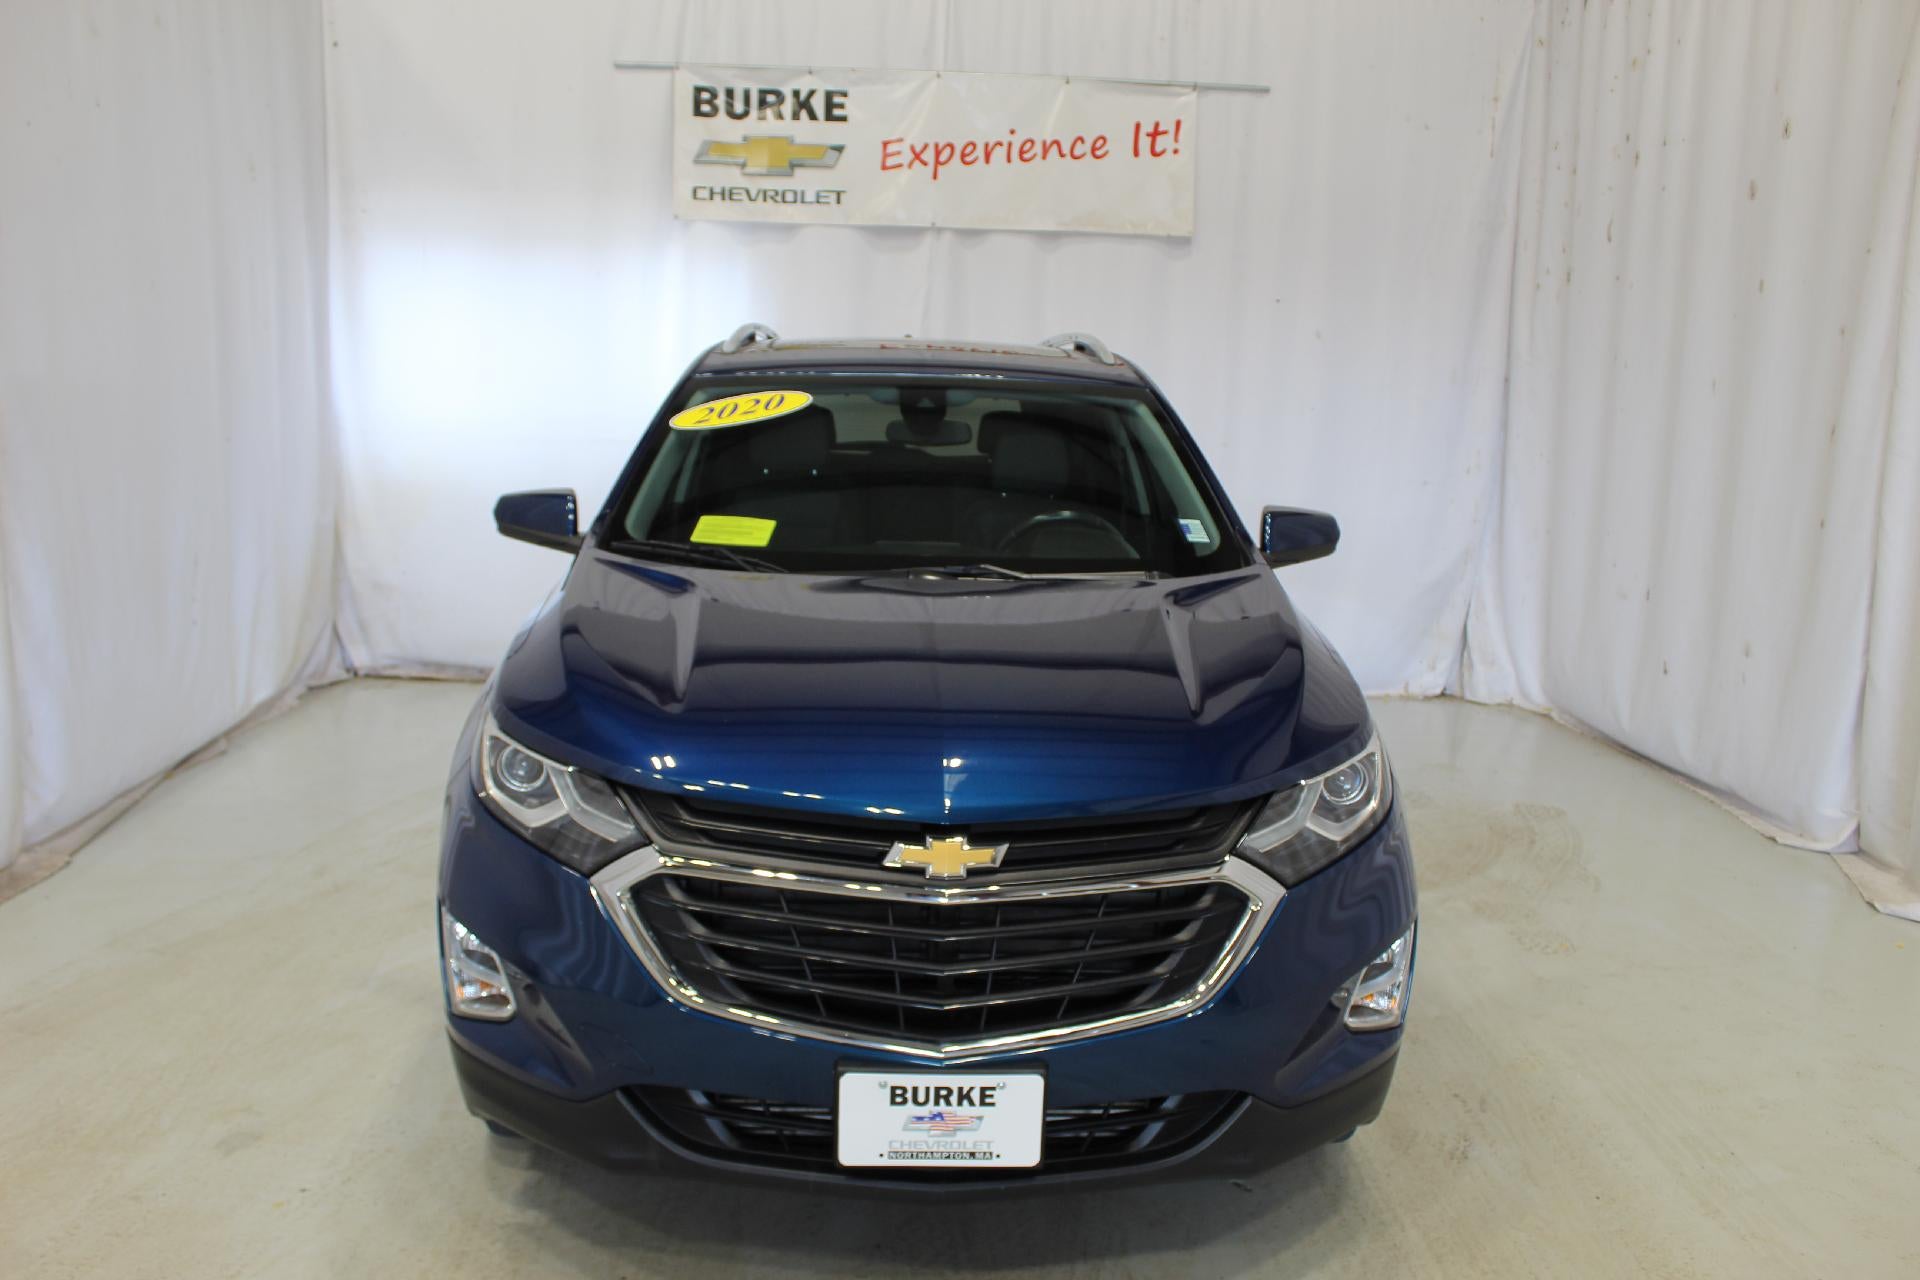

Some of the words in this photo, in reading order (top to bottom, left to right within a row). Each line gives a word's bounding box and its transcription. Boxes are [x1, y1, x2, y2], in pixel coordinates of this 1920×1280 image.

[692, 85, 848, 122] BURKE
[879, 128, 1110, 180] Experience
[1131, 119, 1183, 158] It!
[692, 185, 847, 205] CHEVROLET
[694, 393, 785, 425] 2020
[889, 1086, 997, 1107] BURKE
[888, 1140, 995, 1150] CHEVROLET
